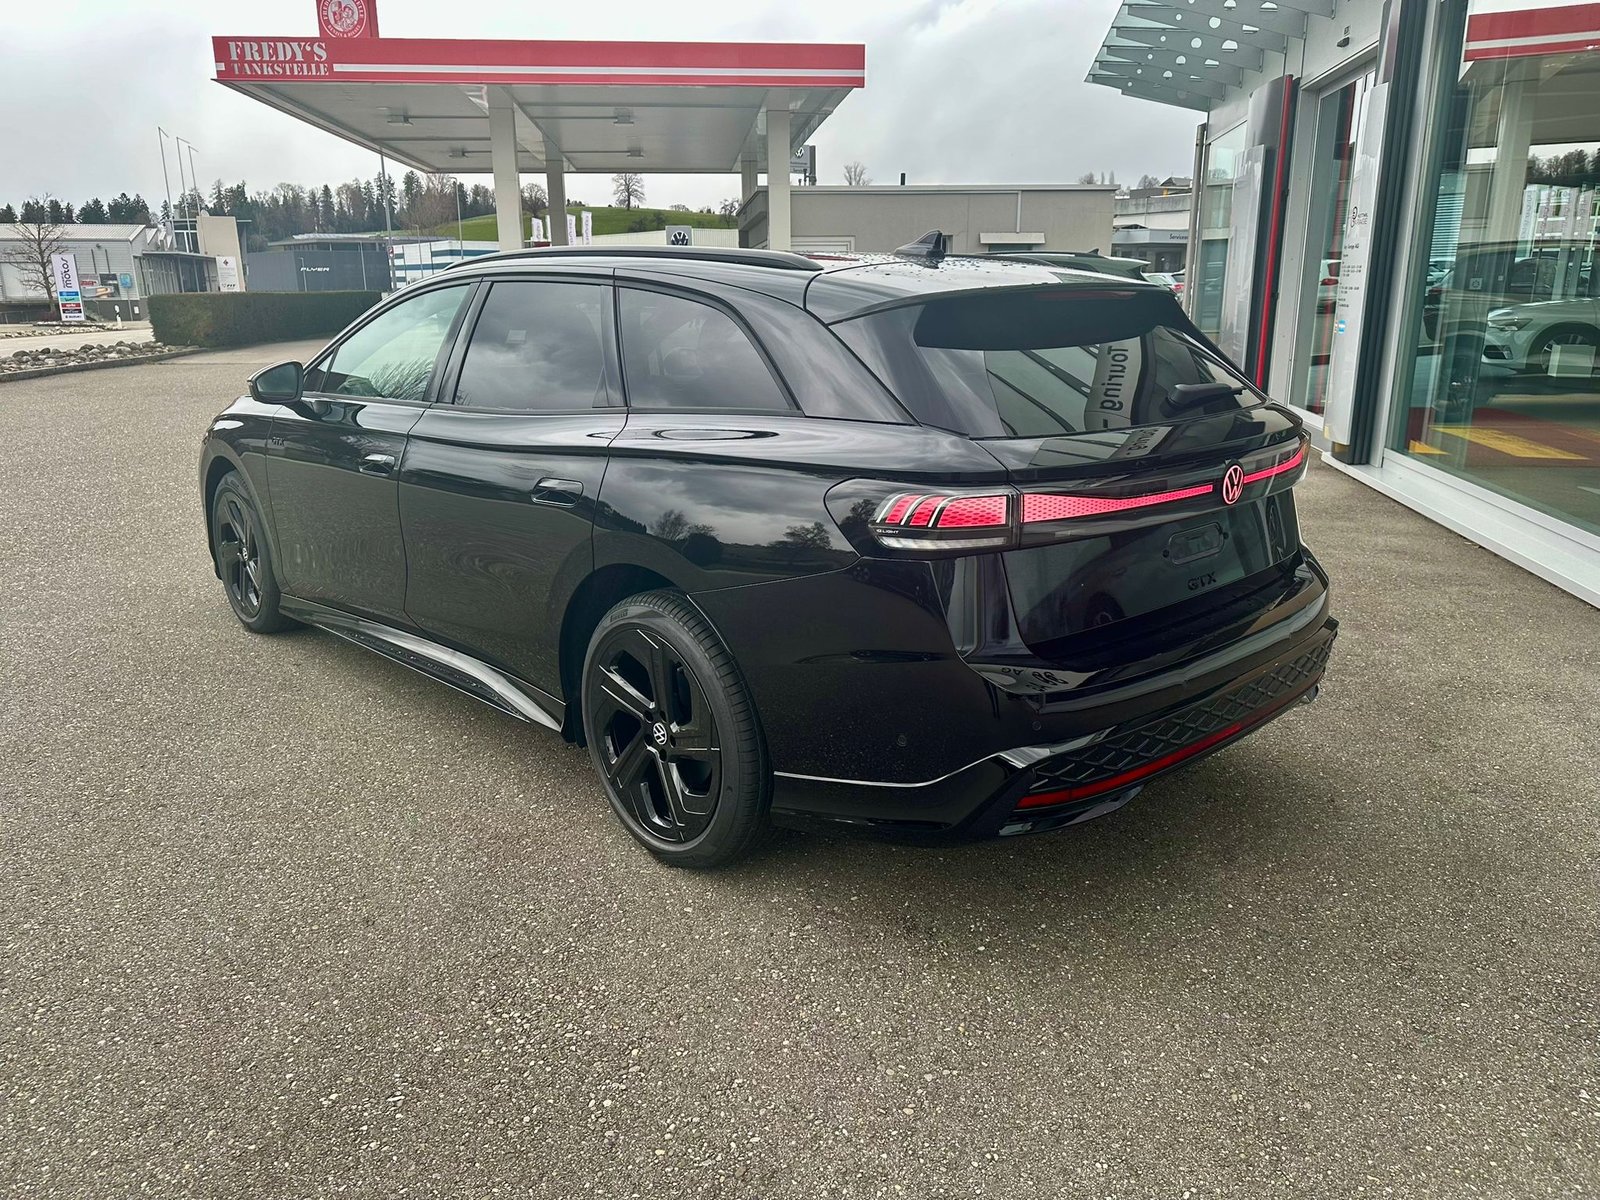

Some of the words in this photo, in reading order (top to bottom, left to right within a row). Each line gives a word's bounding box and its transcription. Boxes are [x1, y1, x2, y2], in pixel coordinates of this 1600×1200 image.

[228, 41, 328, 62] FREDY'S
[231, 63, 329, 75] TANKSTELLE
[61, 257, 72, 288] motos
[1187, 572, 1217, 591] GTX
